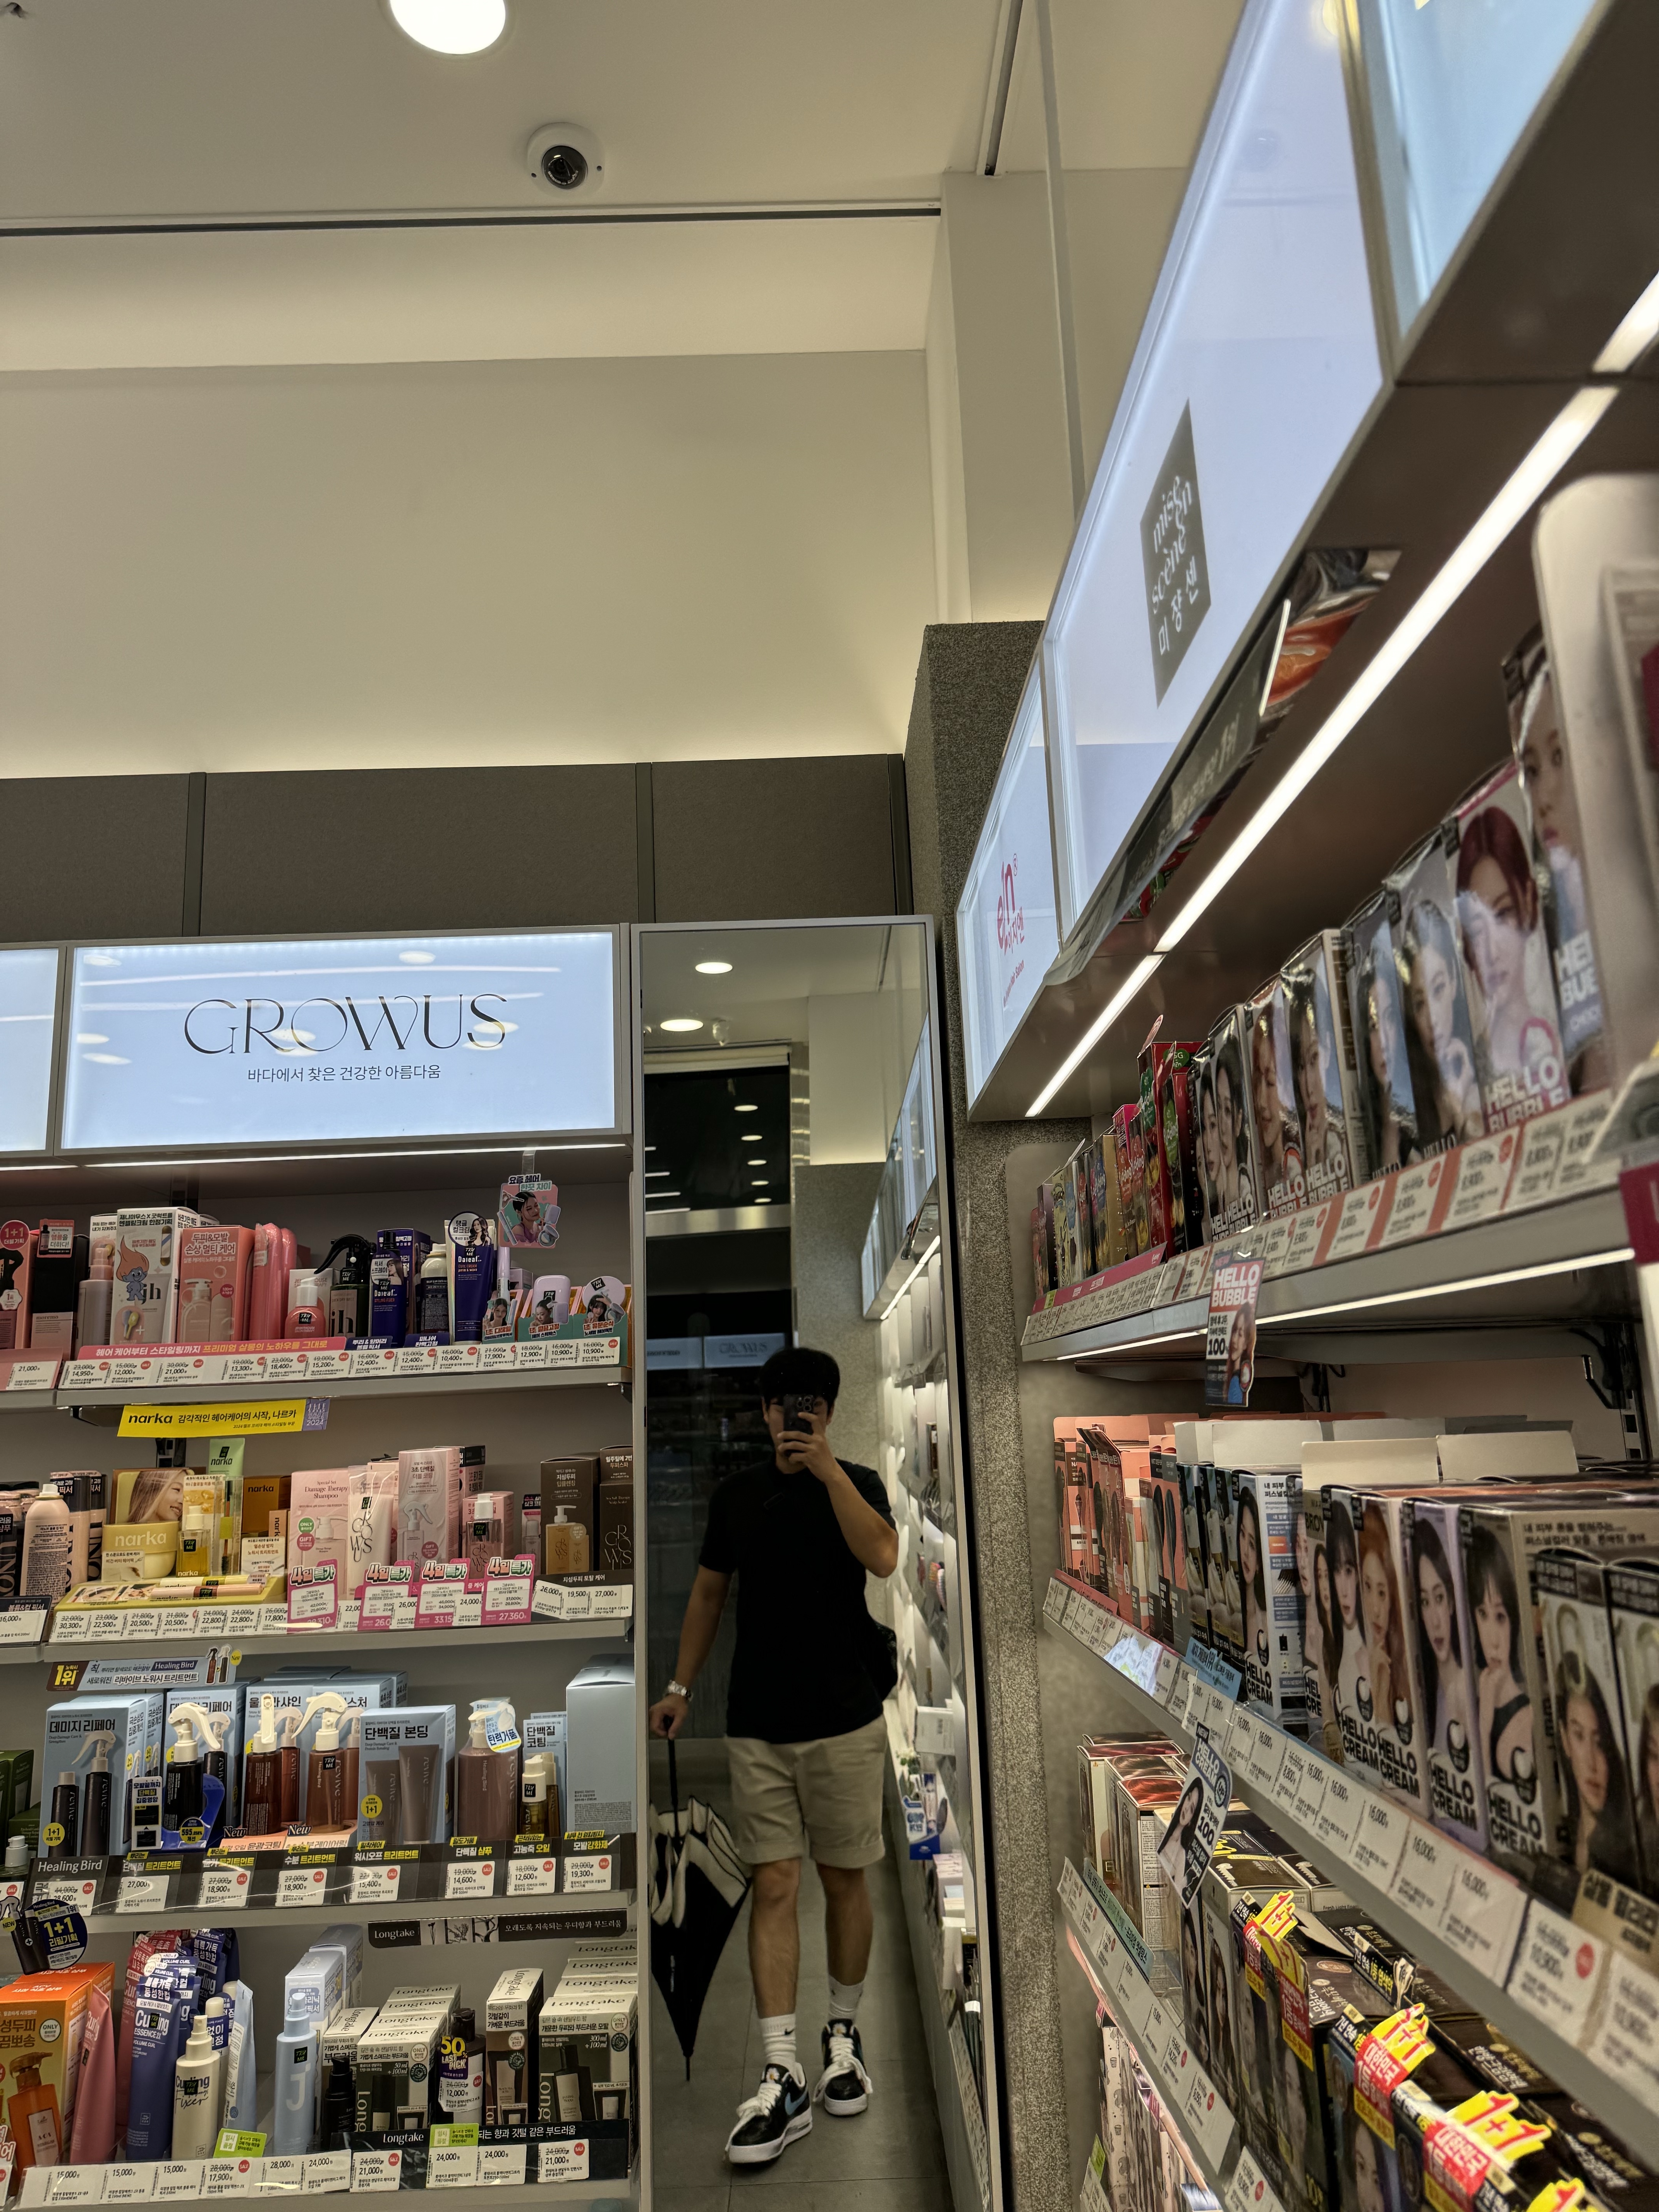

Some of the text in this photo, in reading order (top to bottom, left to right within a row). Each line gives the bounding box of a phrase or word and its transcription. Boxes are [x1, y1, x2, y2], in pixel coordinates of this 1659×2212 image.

[184, 994, 508, 1054] GROWUS
[248, 1065, 441, 1082] 바다에서 찾은 건강한 아름다움
[1306, 1156, 1346, 1193] HELLO
[1267, 1175, 1305, 1209] HELLO
[5, 1227, 24, 1238] 1+1
[193, 1232, 229, 1243] 두피&모발
[185, 1243, 236, 1255] 손상 멀티 케어
[1213, 1264, 1260, 1290] HELLO
[1211, 1286, 1257, 1307] BUBBLE
[114, 1348, 148, 1356] 케어부터
[150, 1345, 201, 1355] 스타일링까지
[202, 1344, 237, 1353] 프리미엄
[302, 1340, 328, 1349] 그대로
[1208, 1338, 1226, 1355] 100
[128, 1412, 173, 1424] narka
[179, 1410, 297, 1423] 감각적인 헤어케어의 시작, 나르카
[211, 1456, 233, 1466] narka
[115, 1531, 167, 1547] narka
[367, 1564, 411, 1582] 4일 특가
[423, 1562, 467, 1580] 4일 특가
[488, 1558, 532, 1577] 4일 특가
[291, 1566, 335, 1585] 4일 특가
[155, 1662, 179, 1671] Healing
[55, 1665, 77, 1686] 1위
[115, 1676, 141, 1684] 리바이브
[143, 1675, 163, 1683] 노워시
[164, 1673, 198, 1682] 트리트먼트
[1245, 1660, 1272, 1693] HELLO
[1247, 1676, 1273, 1707] CREAM
[282, 1696, 301, 1707] 샤인
[49, 1719, 115, 1733] 데미지 리페어
[365, 1725, 428, 1740] 단백질 본딩
[527, 1725, 555, 1737] 단백질
[1197, 1724, 1209, 1738] NEW
[1340, 1712, 1377, 1750] HELLO
[488, 1728, 518, 1746] 탄력거품
[527, 1737, 546, 1748] 코팅
[1342, 1734, 1379, 1772] CREAM
[1379, 1734, 1417, 1775] HELLO
[1380, 1757, 1420, 1799] CREAM
[1431, 1762, 1474, 1805] HELLO
[366, 1806, 377, 1814] 1+1
[1432, 1786, 1478, 1831] CREAM
[1488, 1790, 1542, 1840] HELLO
[48, 1828, 60, 1836] 1+1
[223, 1827, 247, 1838] New
[288, 1824, 311, 1836] New
[248, 1841, 282, 1850] 윤광코팅
[536, 1843, 550, 1853] 오일
[285, 1854, 336, 1865] 수분 트리트먼트
[354, 1850, 419, 1861] 워시오프 트리트먼트
[38, 1860, 103, 1873] Healing Bird
[145, 1860, 181, 1871] 트리트먼트
[66, 1905, 77, 1913] 1위
[44, 1917, 74, 1937] 1+1
[505, 1923, 534, 1932] 오래도록
[535, 1922, 562, 1931] 지속되는
[564, 1920, 592, 1930] 우디향과
[49, 1933, 78, 1947] 리필기획
[374, 1927, 415, 1940] Longtake
[565, 1977, 637, 1987] Longtake
[396, 1986, 452, 1995] Longtake
[388, 1999, 446, 2009] Longtake
[551, 1997, 626, 2008] Longtake
[378, 2015, 437, 2024] Longtake
[134, 2028, 156, 2038] ESSENCE
[368, 2029, 429, 2039] Longtake
[441, 2035, 468, 2058] 50%
[441, 2052, 457, 2063] LAST
[449, 2058, 466, 2070] PICK
[1464, 2095, 1545, 2152] 1+1
[495, 2125, 576, 2138] 향과 깃털 같은 부드러움
[383, 2132, 424, 2145] Longtake
